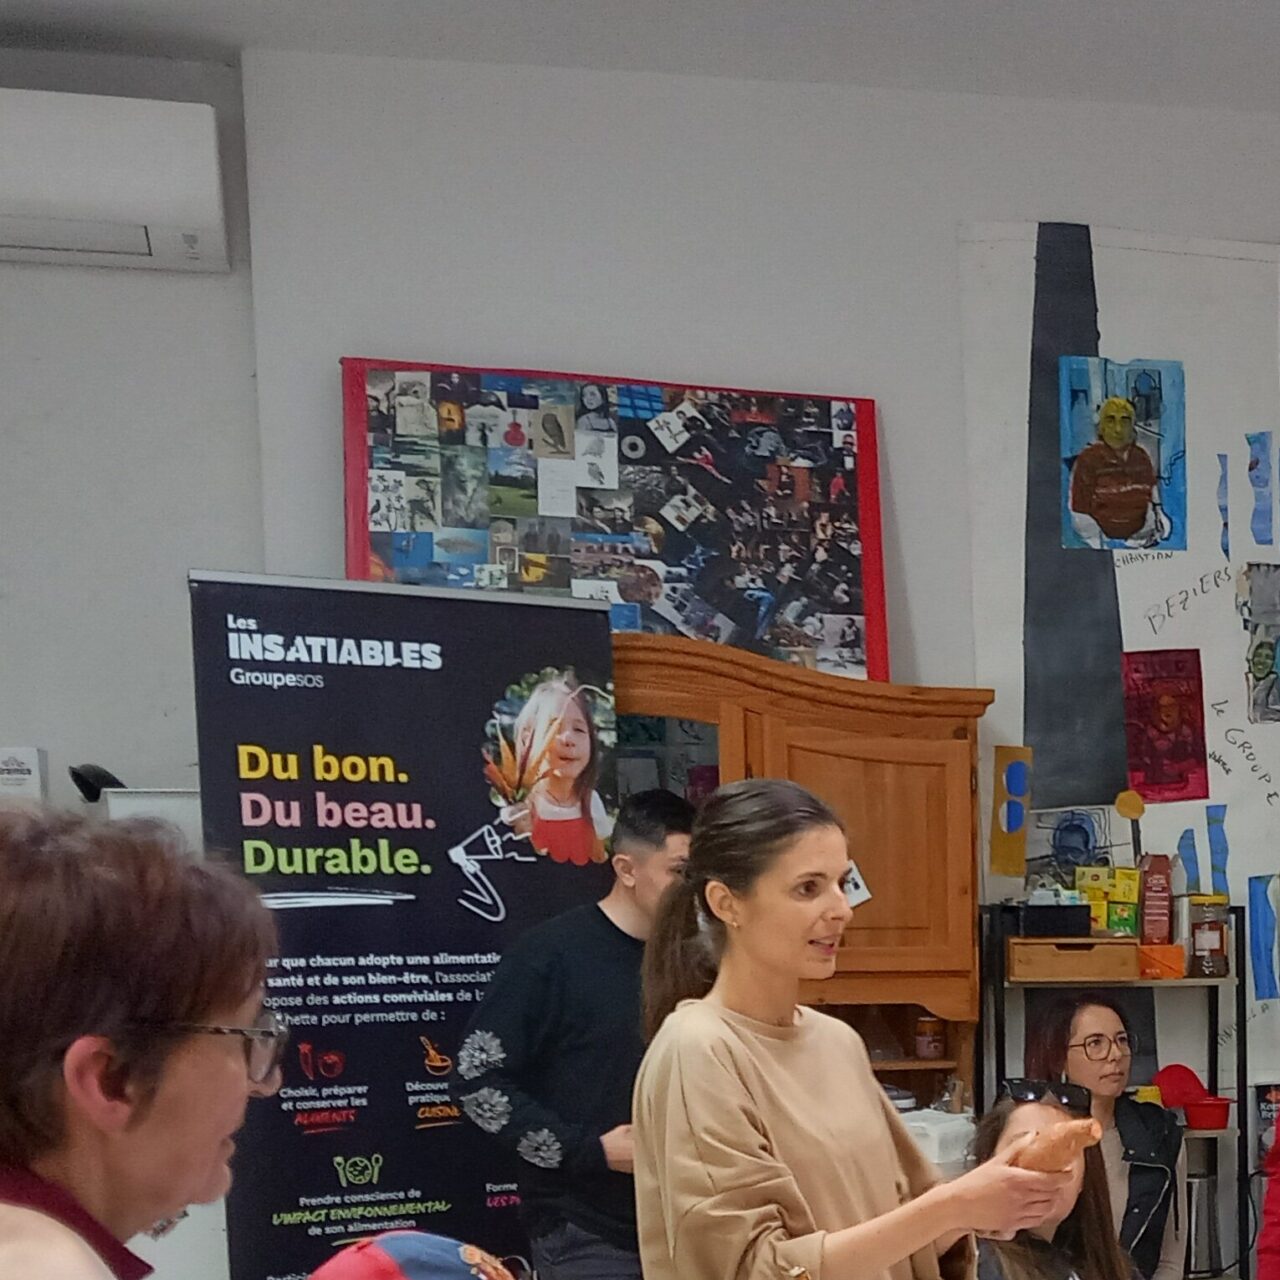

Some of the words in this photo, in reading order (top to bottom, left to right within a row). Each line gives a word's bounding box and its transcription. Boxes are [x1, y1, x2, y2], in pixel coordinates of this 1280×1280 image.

[227, 613, 258, 630] Les
[227, 632, 443, 670] INSATIABLES
[237, 744, 299, 781] Du
[313, 745, 409, 783] bon.
[240, 791, 301, 828] Du
[316, 793, 437, 830] beau.
[243, 838, 433, 875] Durable.
[281, 957, 307, 971] que
[309, 955, 355, 968] chacun
[357, 954, 404, 969] adopte
[406, 955, 430, 966] une
[267, 973, 304, 988] santé
[306, 976, 321, 986] et
[323, 973, 340, 986] de
[342, 974, 366, 986] son
[367, 971, 433, 986] bien-être,
[434, 970, 497, 984] l'associat
[262, 995, 303, 1009] opose
[306, 993, 329, 1006] des
[331, 992, 380, 1005] actions
[383, 990, 454, 1004] conviviales
[455, 990, 473, 1002] de
[285, 1011, 318, 1026] hette
[321, 1012, 351, 1027] pour
[354, 1010, 418, 1028] permettre
[421, 1009, 438, 1021] de
[321, 1084, 369, 1098] préparer
[405, 1081, 449, 1092] Découvr
[281, 1102, 293, 1111] et
[295, 1099, 349, 1110] conserver
[350, 1096, 369, 1107] les
[407, 1092, 452, 1105] pratiqu
[299, 1192, 342, 1207] Prendre
[343, 1189, 405, 1203] conscience
[407, 1188, 422, 1199] de
[307, 1225, 323, 1237] de
[324, 1223, 346, 1235] son
[347, 1218, 416, 1233] alimentation
